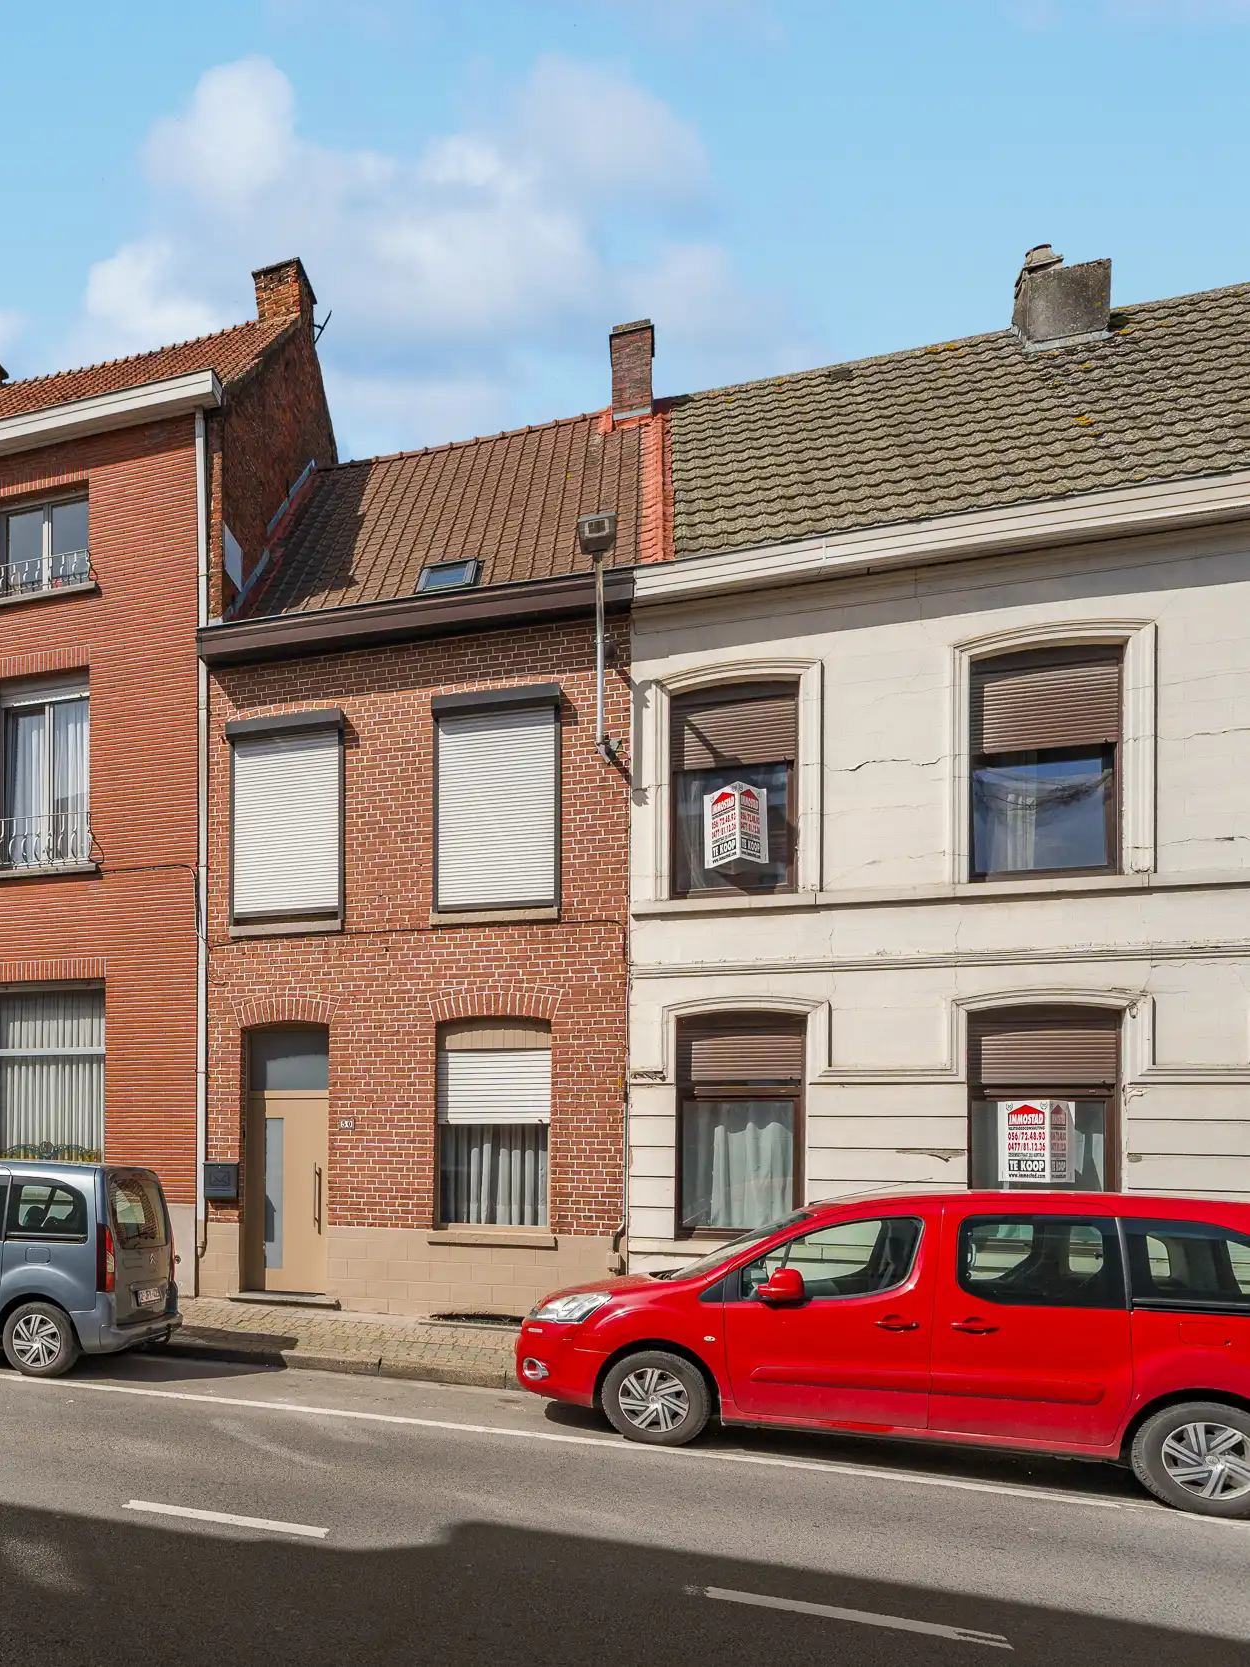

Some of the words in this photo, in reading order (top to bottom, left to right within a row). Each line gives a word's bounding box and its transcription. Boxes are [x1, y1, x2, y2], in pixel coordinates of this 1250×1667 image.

[712, 846, 719, 857] TE
[719, 840, 736, 855] KOOP
[1009, 1113, 1044, 1125] IMMOSTAD
[1009, 1160, 1019, 1171] TE
[1021, 1160, 1045, 1172] KOOP
